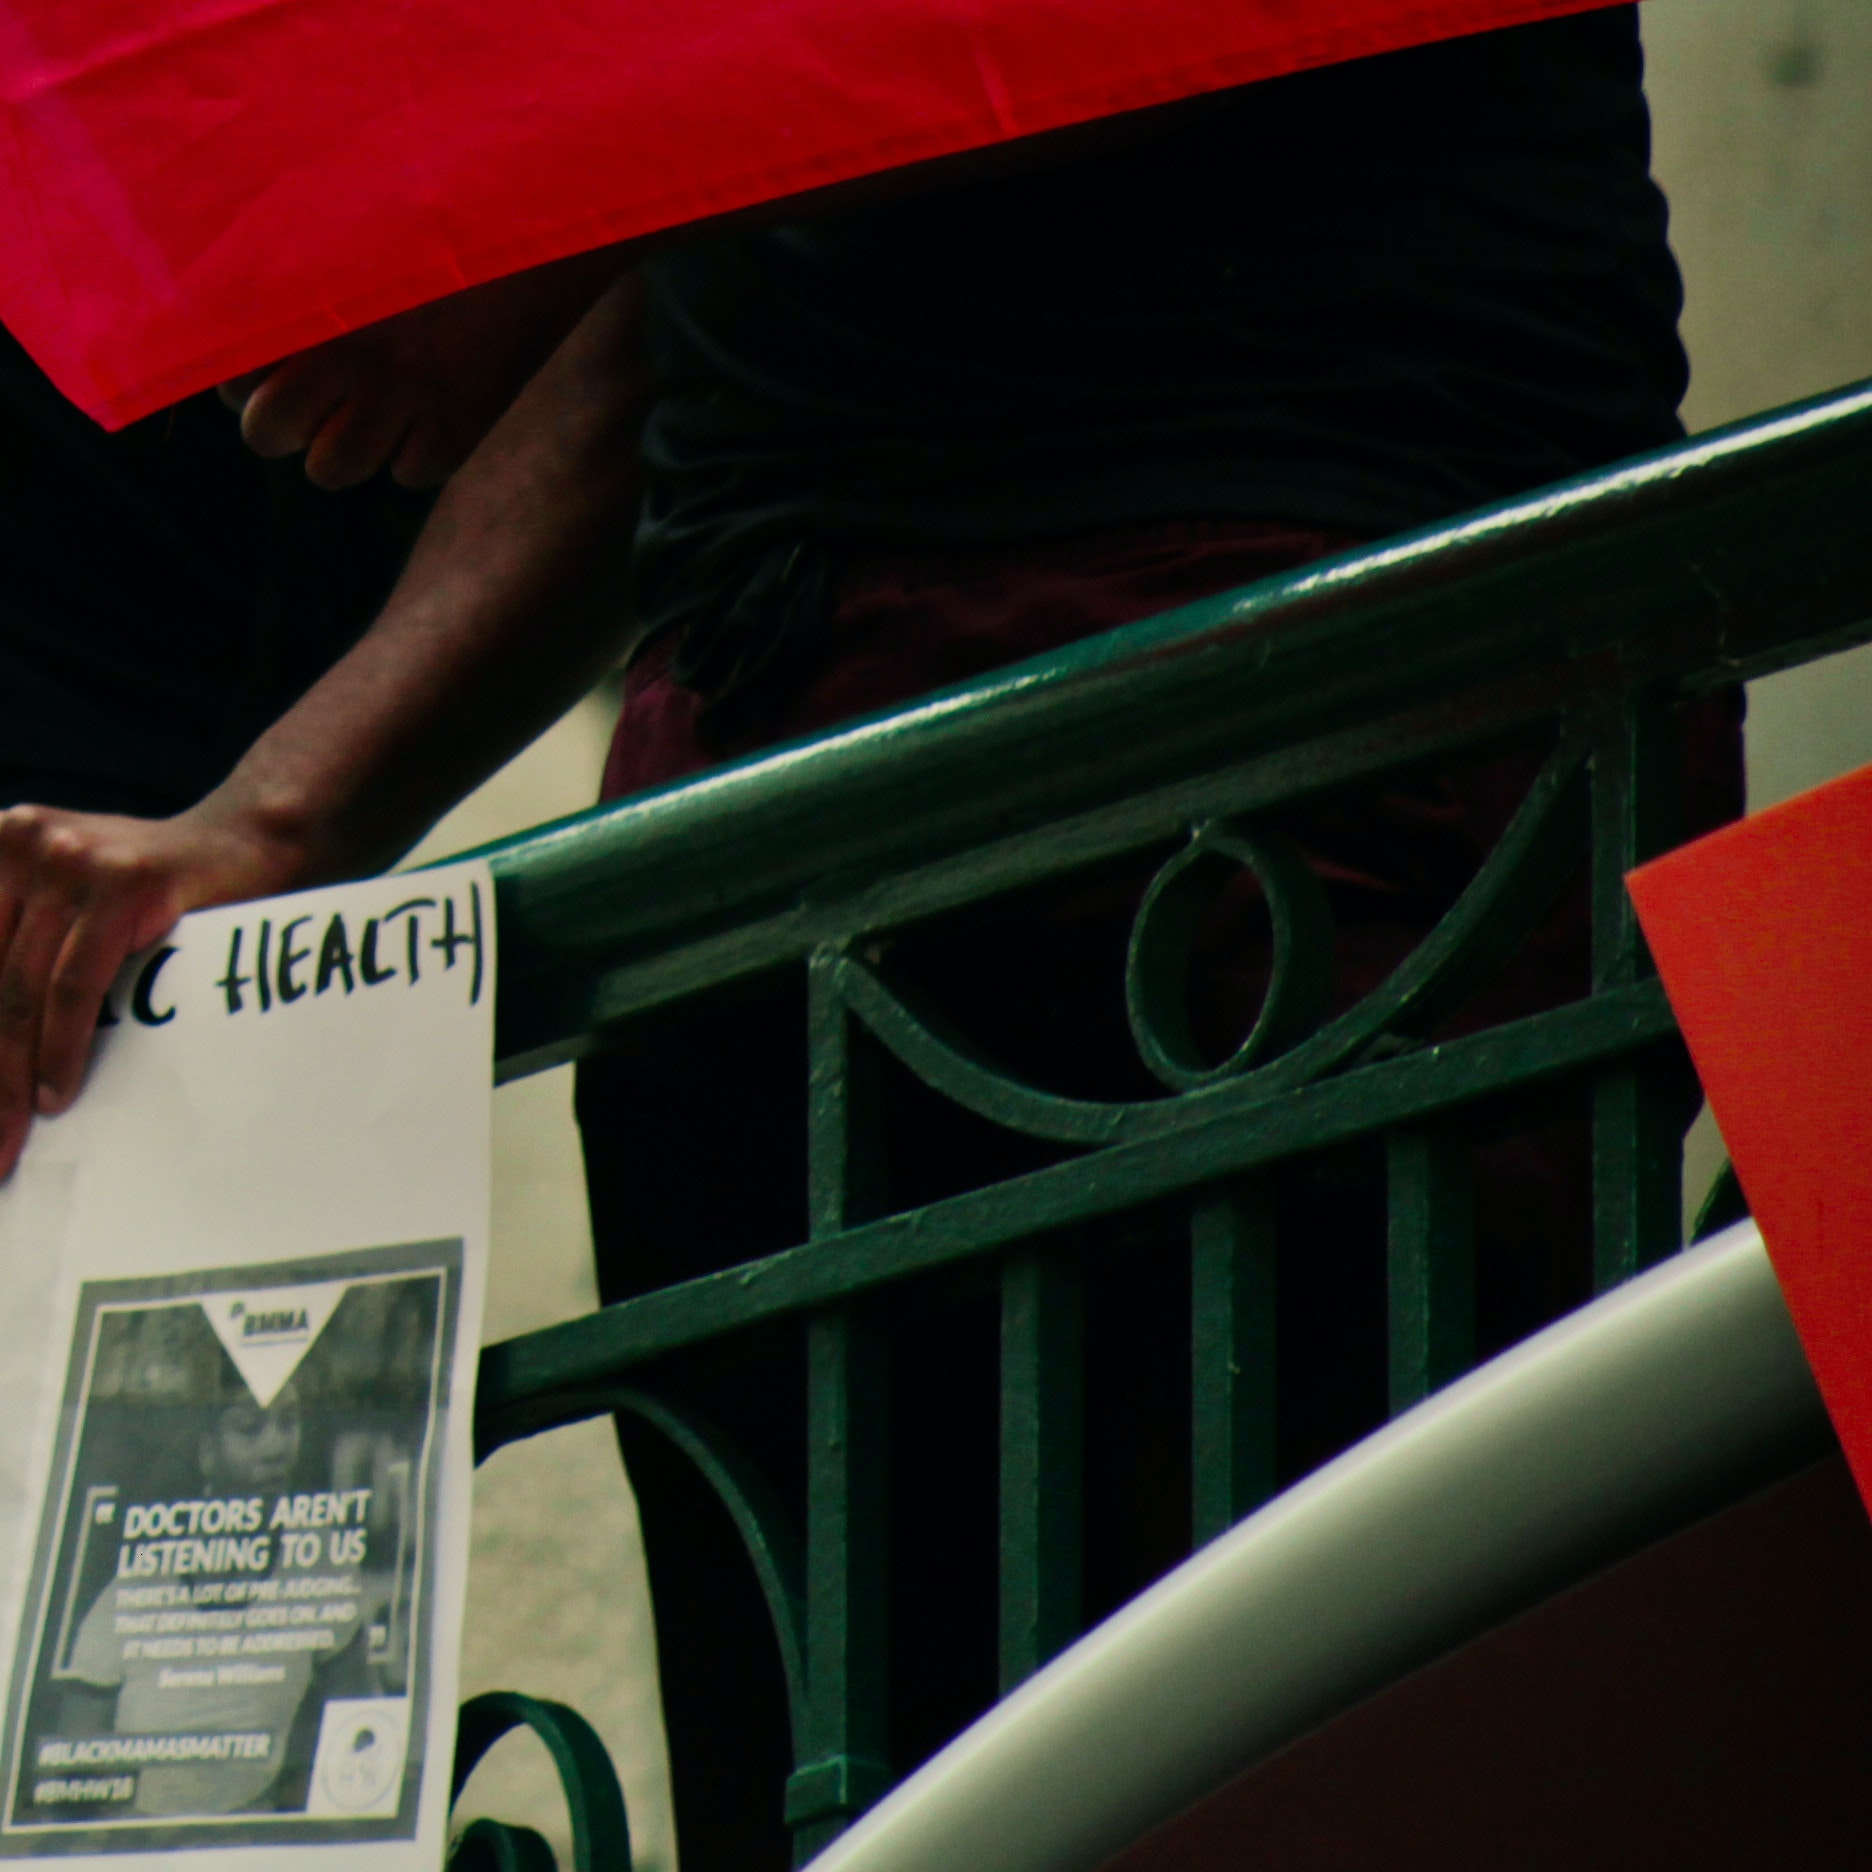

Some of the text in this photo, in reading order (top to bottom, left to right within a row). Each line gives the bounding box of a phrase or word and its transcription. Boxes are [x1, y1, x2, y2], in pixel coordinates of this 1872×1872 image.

[216, 883, 483, 1016] HEALTH
[122, 1488, 372, 1539] DOCTORS AREN'T
[115, 1528, 368, 1578] LISTENING TO US
